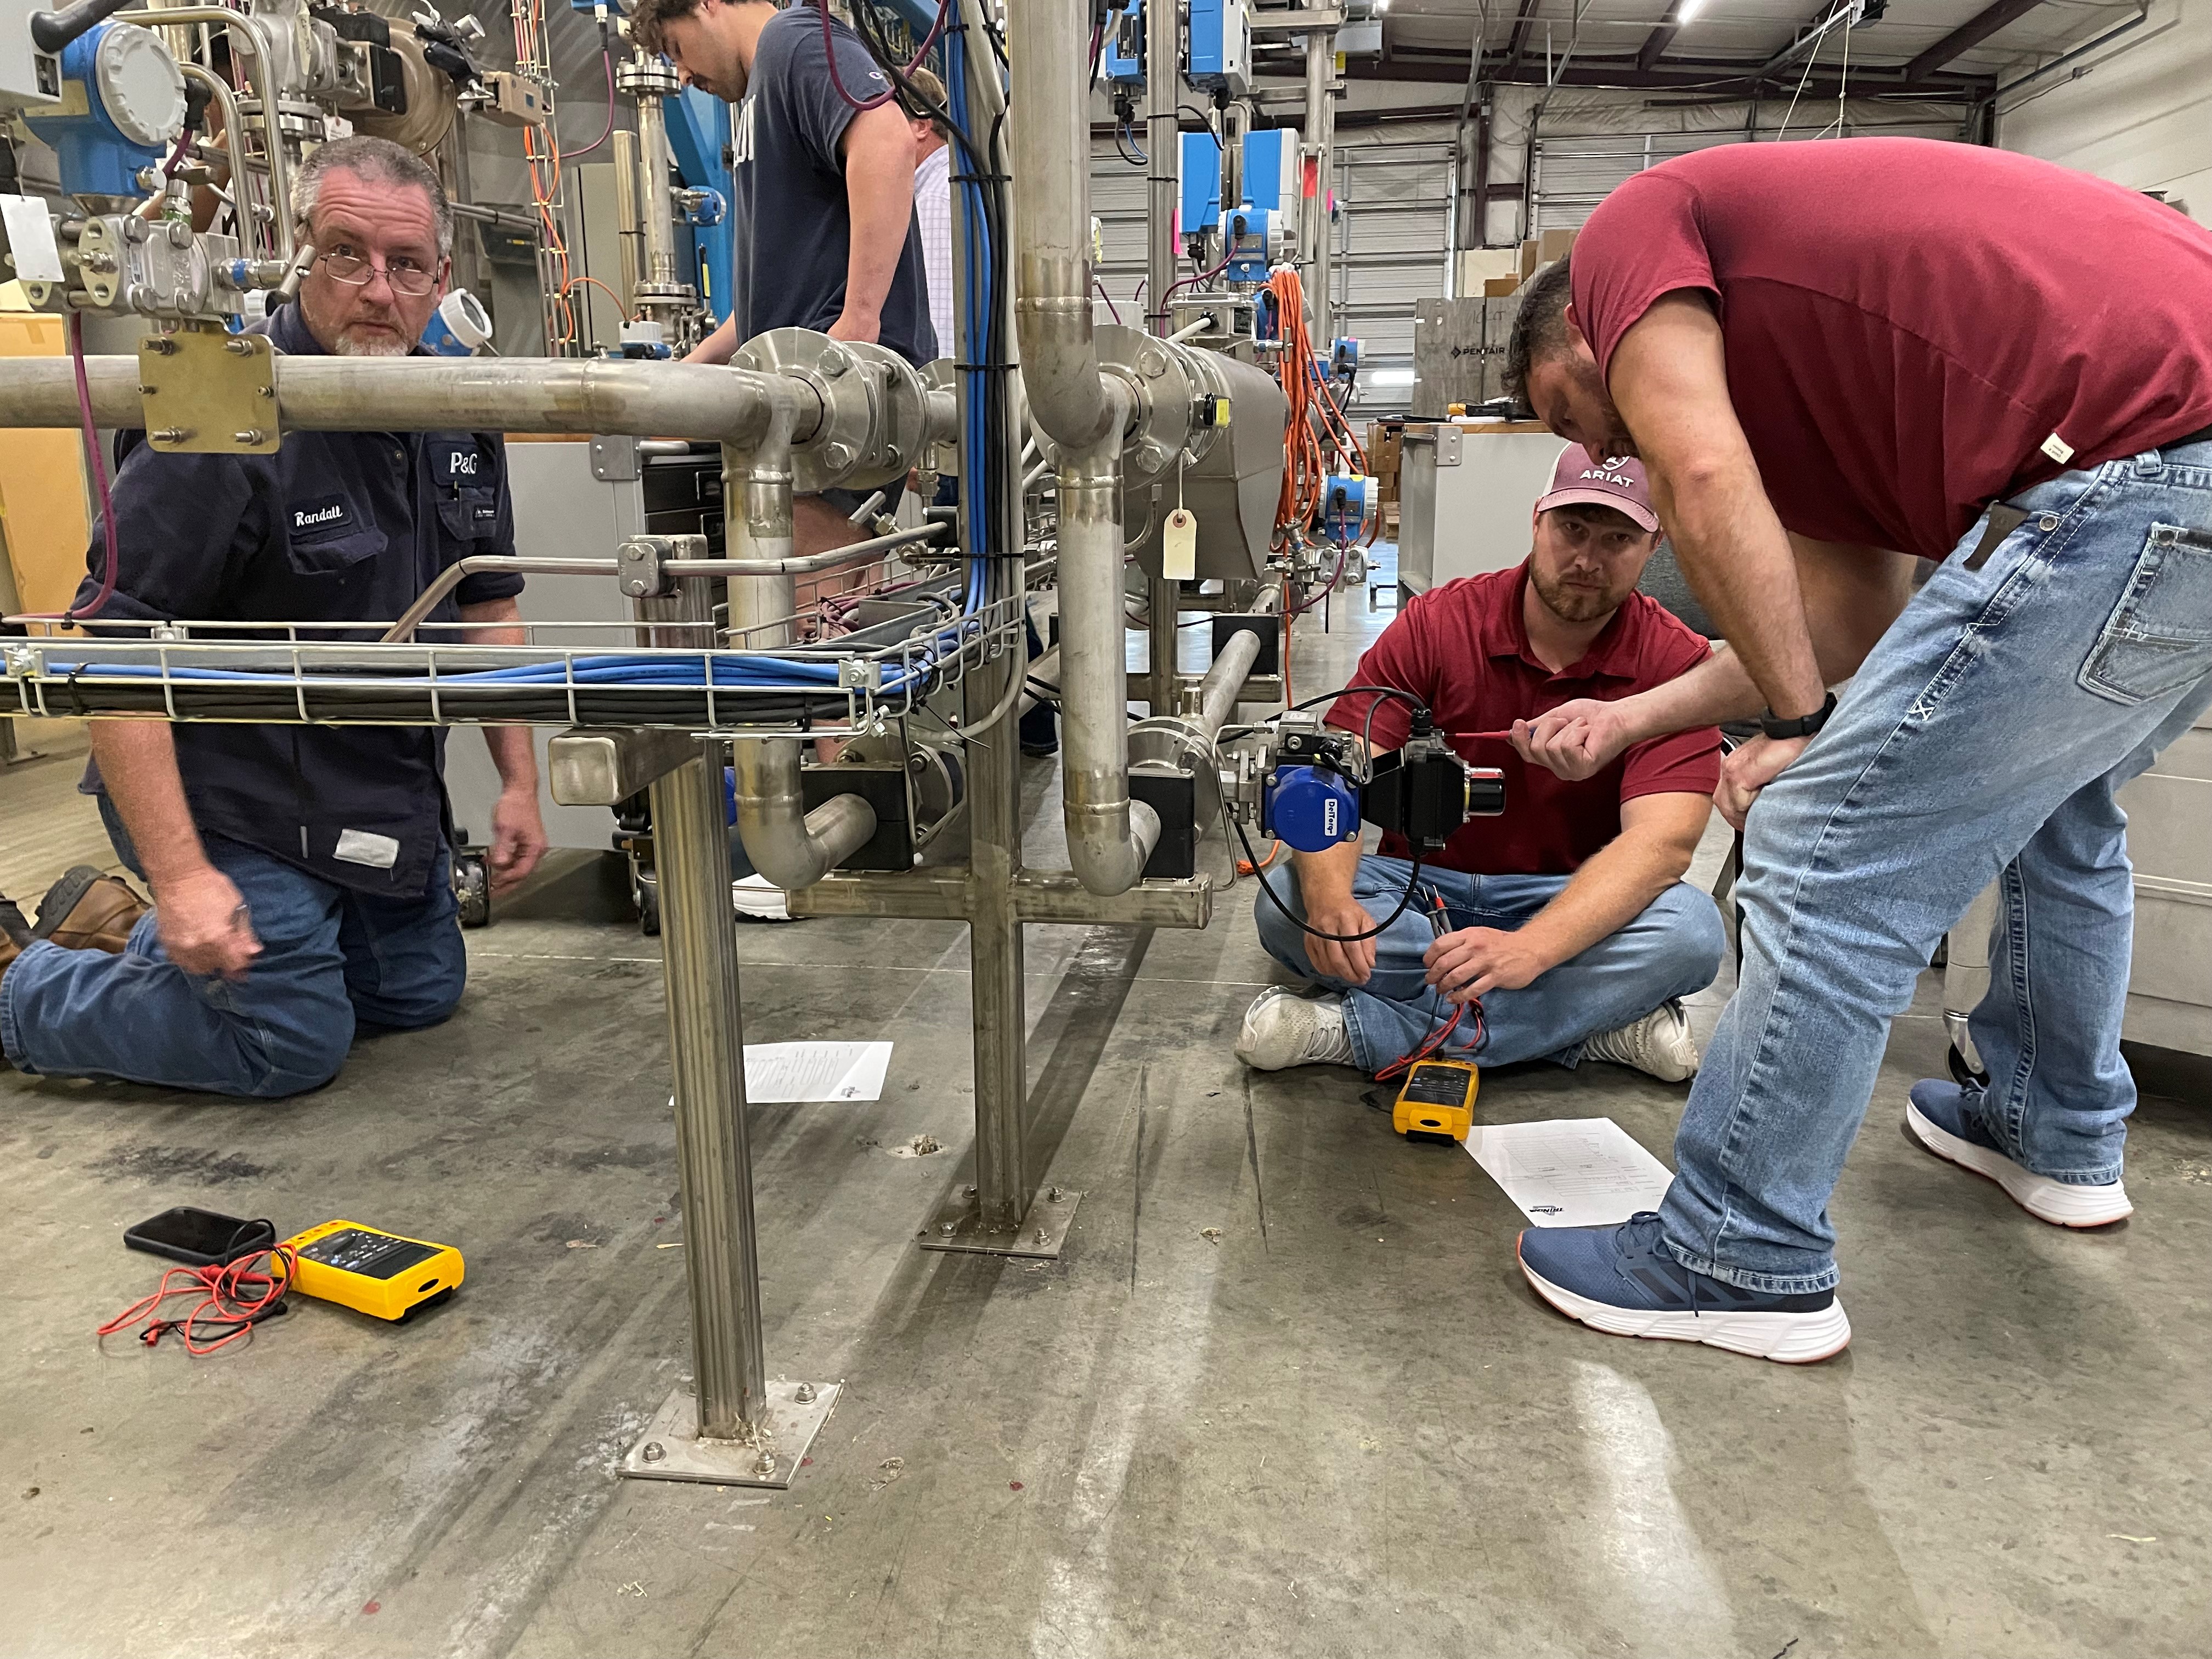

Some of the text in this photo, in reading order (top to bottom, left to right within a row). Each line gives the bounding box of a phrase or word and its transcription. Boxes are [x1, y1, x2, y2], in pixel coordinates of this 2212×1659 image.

[1463, 347, 1505, 355] PENTAIR
[450, 452, 477, 474] P&G
[1579, 470, 1634, 488] ARIAT
[294, 505, 343, 527] Randall
